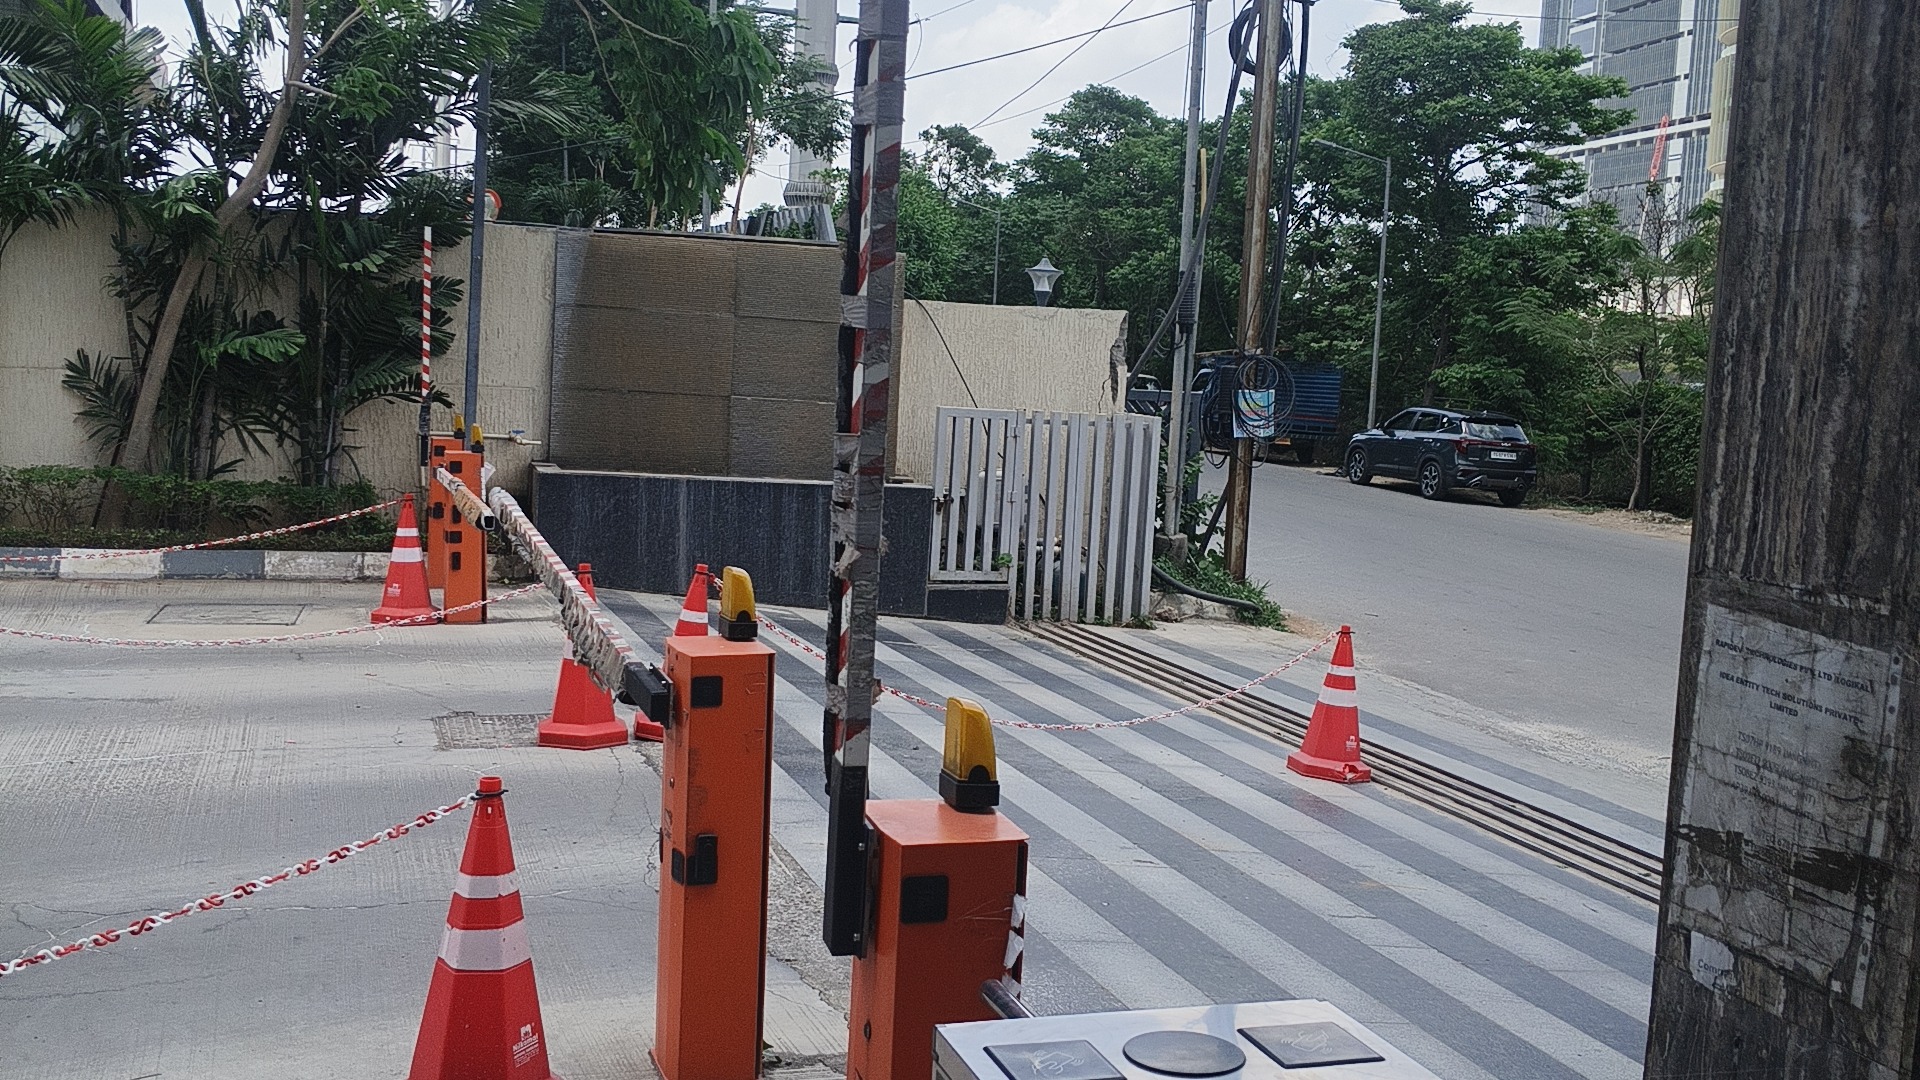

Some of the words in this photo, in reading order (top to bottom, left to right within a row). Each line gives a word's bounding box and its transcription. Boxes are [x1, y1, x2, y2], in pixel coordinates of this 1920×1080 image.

[1817, 670, 1833, 682] LTD
[1761, 685, 1781, 700] TECH
[1781, 692, 1824, 714] SOLUTIONS
[1769, 700, 1799, 718] LIMITED
